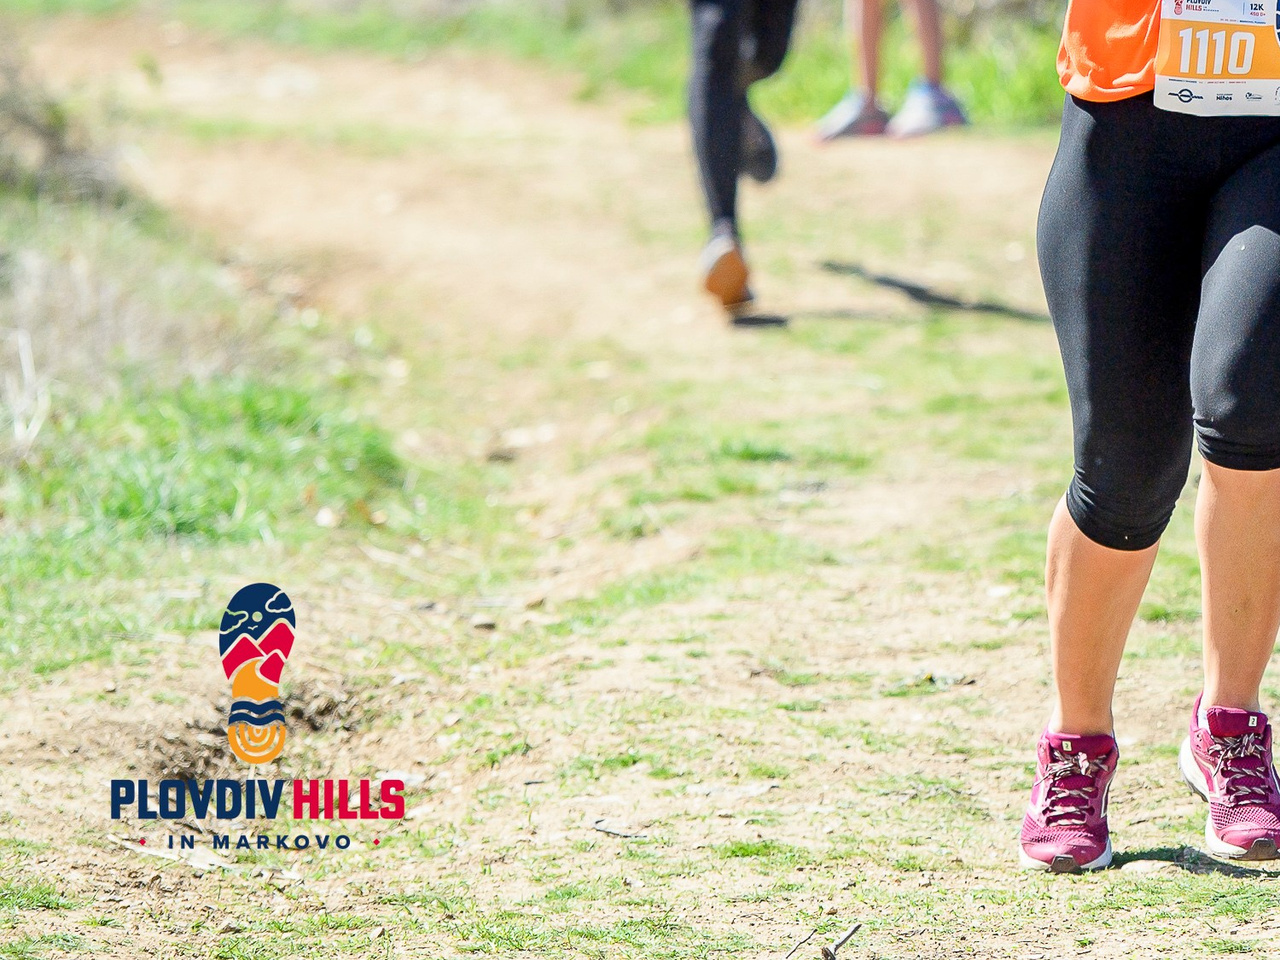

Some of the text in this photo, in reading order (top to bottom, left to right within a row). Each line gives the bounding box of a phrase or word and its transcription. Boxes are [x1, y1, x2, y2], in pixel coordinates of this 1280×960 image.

[1185, 4, 1202, 12] HILLS
[1250, 3, 1264, 11] 12K
[1179, 27, 1256, 75] 1110
